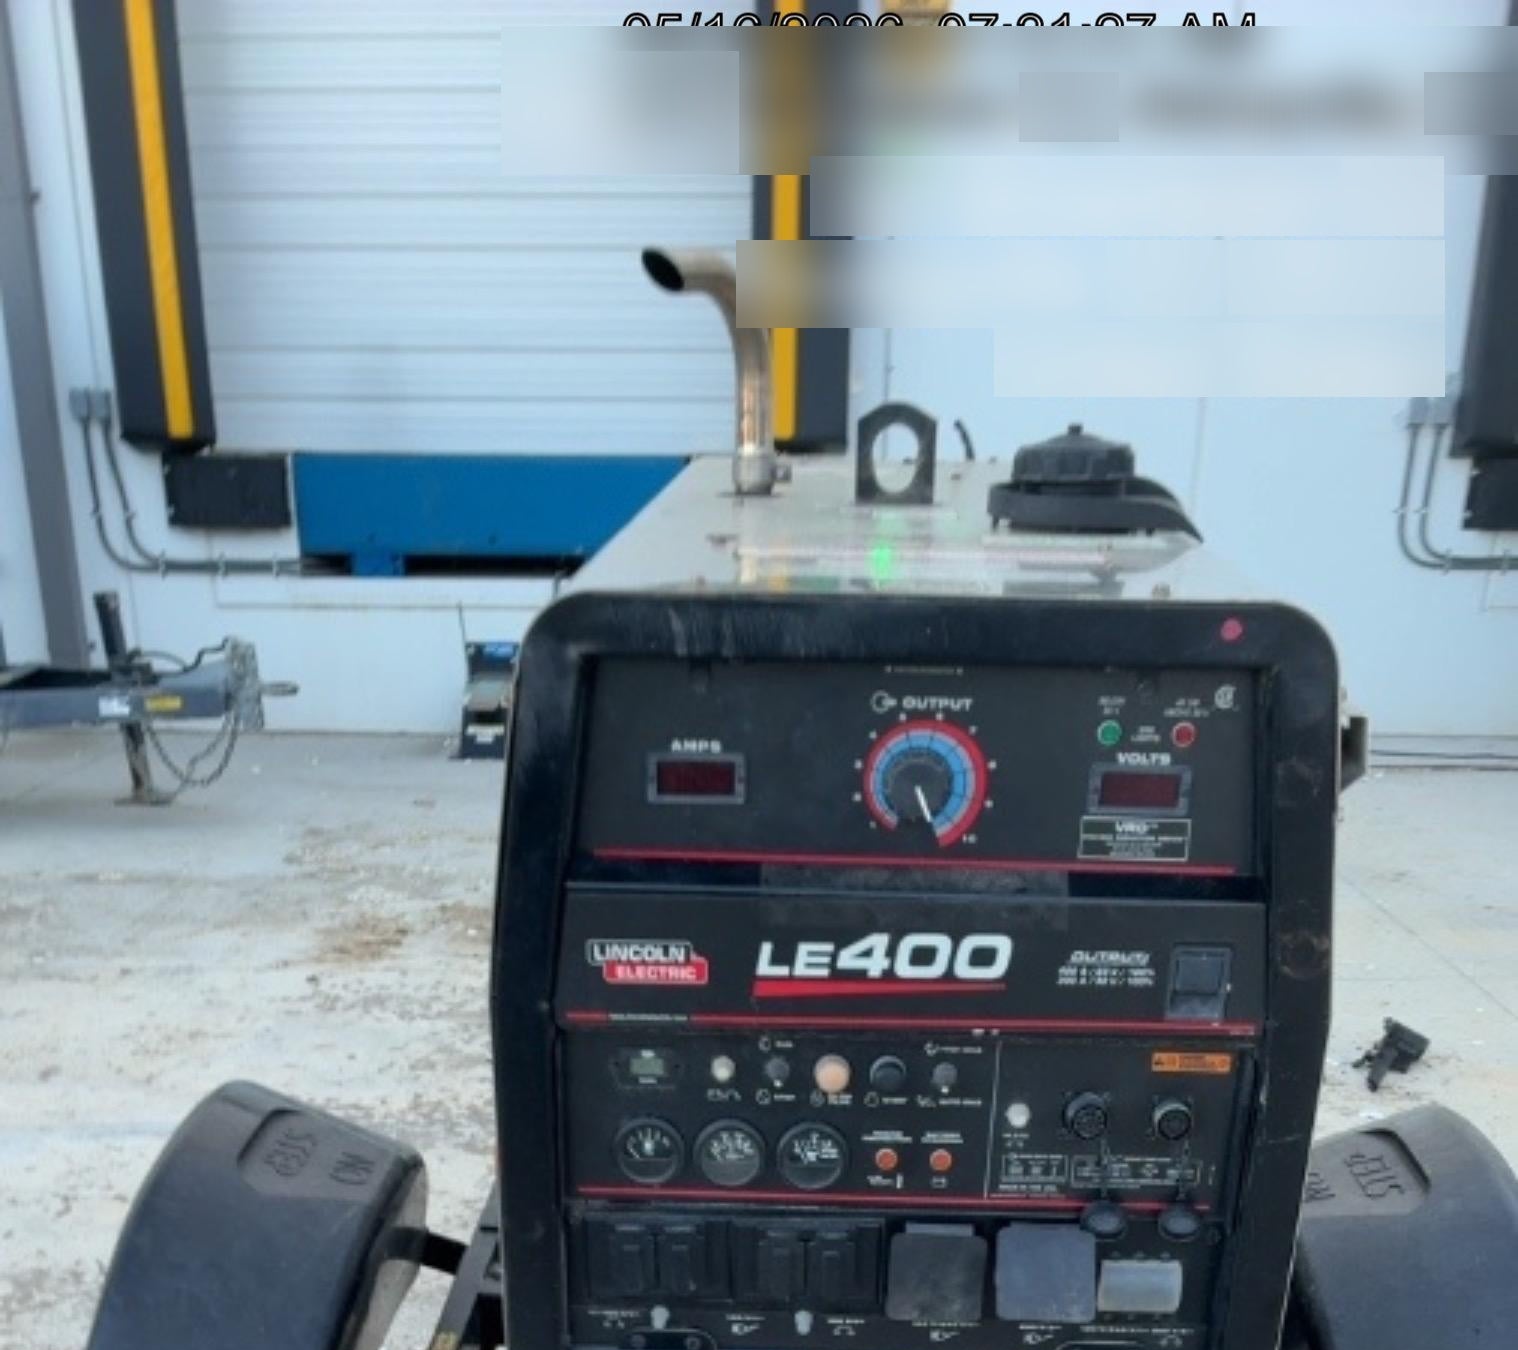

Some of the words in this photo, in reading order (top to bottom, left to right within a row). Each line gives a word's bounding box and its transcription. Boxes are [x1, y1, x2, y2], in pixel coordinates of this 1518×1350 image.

[902, 696, 973, 711] OUTPUT
[671, 738, 722, 753] AMPS
[1116, 752, 1172, 765] VOLTS
[593, 942, 686, 963] LINCOLN
[755, 932, 1012, 979] LE400
[615, 965, 698, 981] ELECTRIC
[1344, 1152, 1405, 1199] STEP
